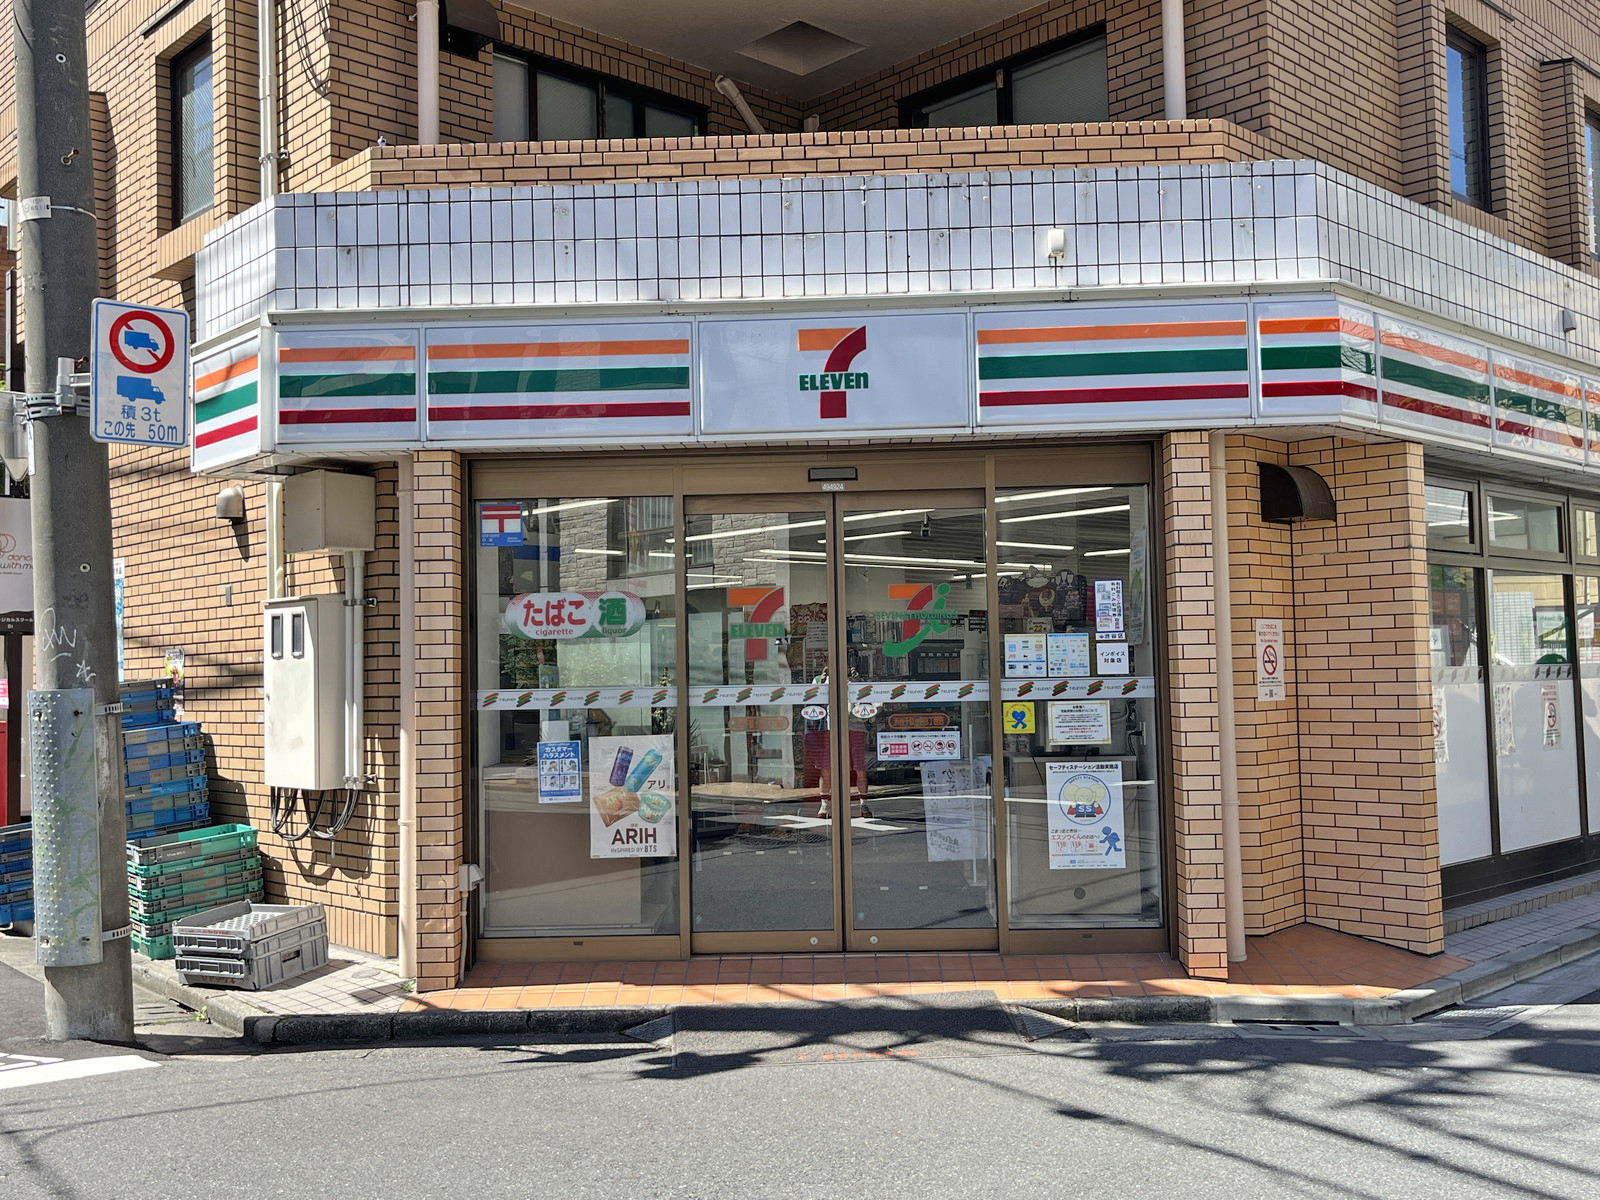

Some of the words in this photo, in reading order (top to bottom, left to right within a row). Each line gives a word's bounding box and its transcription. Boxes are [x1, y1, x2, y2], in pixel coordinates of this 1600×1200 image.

[797, 325, 867, 419] 7
[103, 420, 136, 438] この先
[148, 423, 178, 442] 50m
[523, 597, 586, 627] たばこ
[598, 597, 627, 626] 酒
[535, 627, 574, 637] cigarette
[602, 626, 627, 635] liquor
[728, 587, 785, 661] 7
[542, 751, 576, 759] ハラスメント
[611, 827, 657, 845] ARIH
[644, 845, 658, 853] BTS
